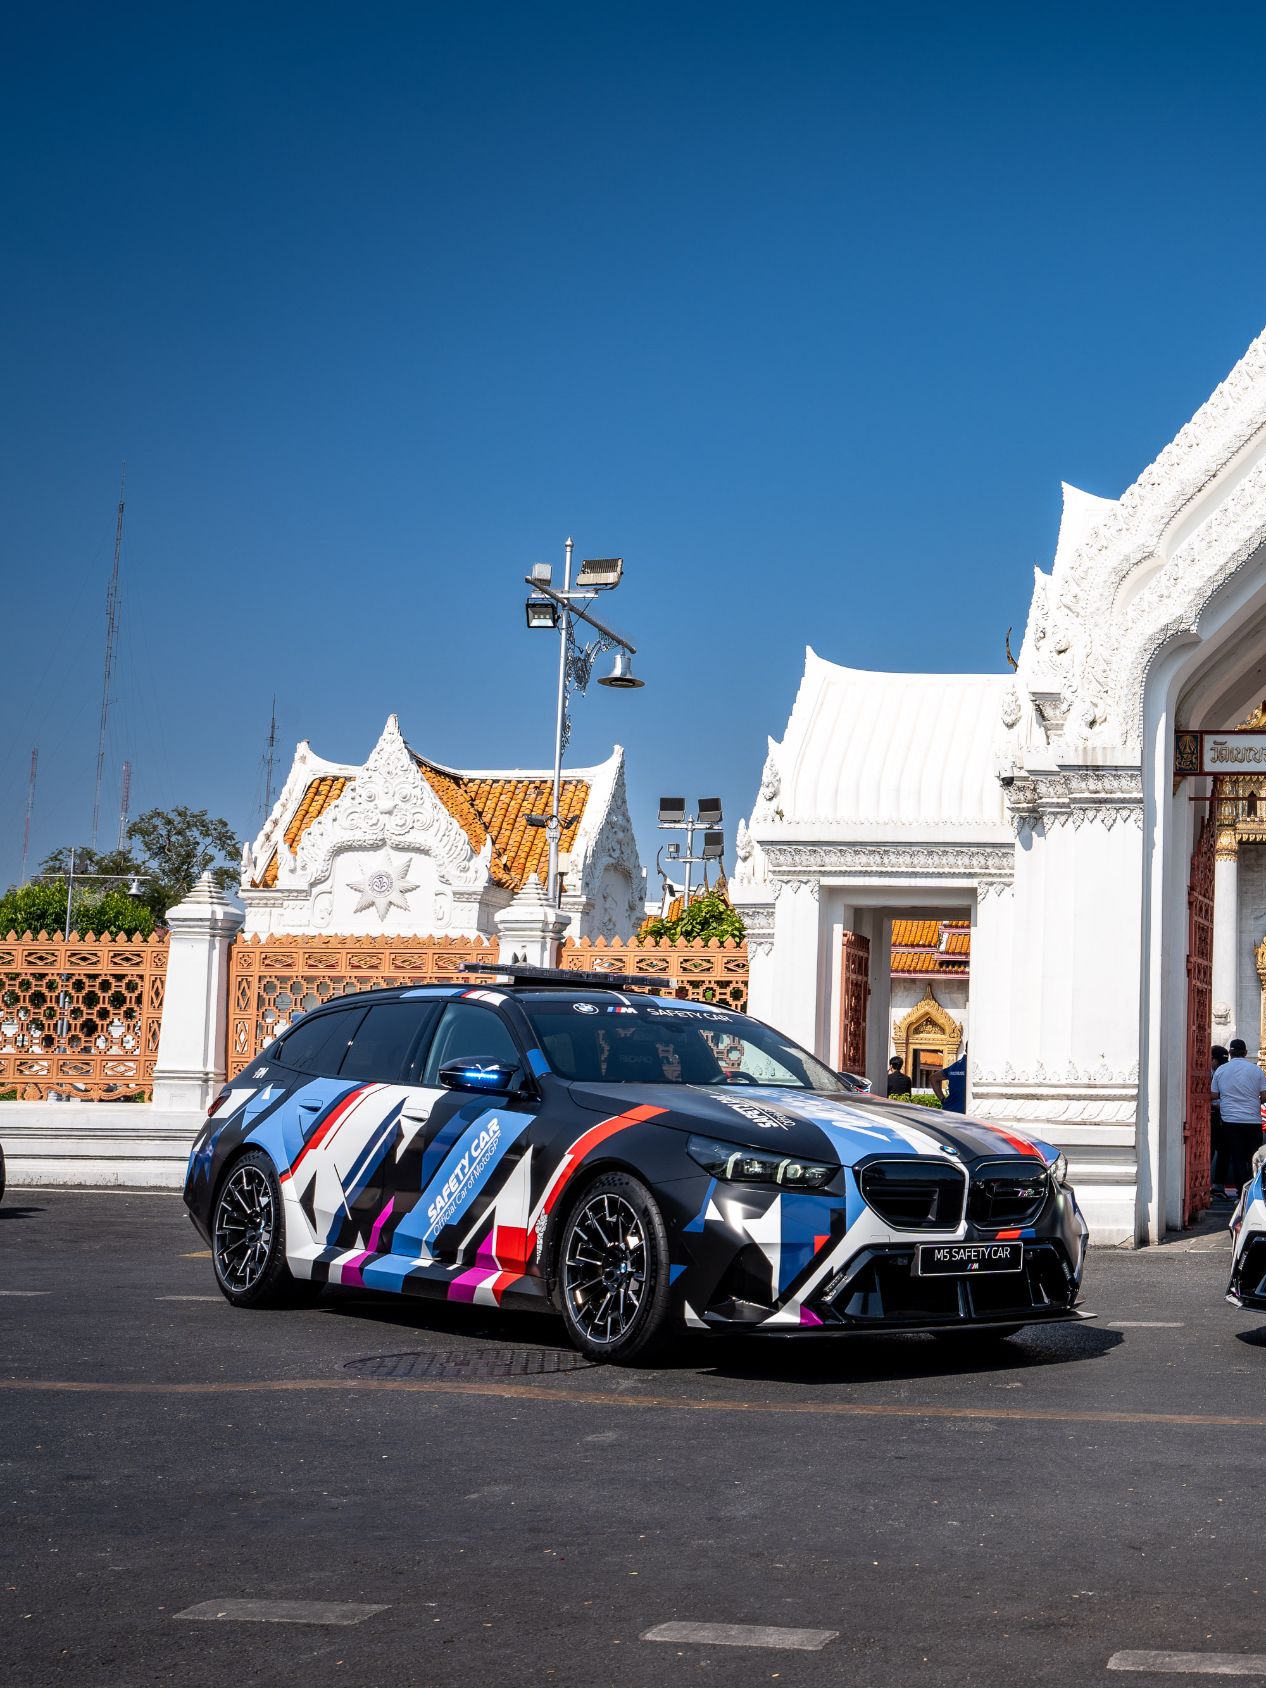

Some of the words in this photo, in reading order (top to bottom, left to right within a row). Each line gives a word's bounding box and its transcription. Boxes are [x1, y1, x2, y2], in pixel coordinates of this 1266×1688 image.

[646, 1008, 703, 1020] SAFETY
[704, 1012, 733, 1023] CAR
[427, 1151, 470, 1223] SAFETY
[471, 1117, 500, 1157] CAR
[433, 1204, 457, 1236] Official
[456, 1187, 468, 1204] Car
[467, 1175, 476, 1189] of
[935, 1250, 949, 1261] M5
[952, 1248, 990, 1260] SAFETY
[992, 1247, 1010, 1259] CAR
